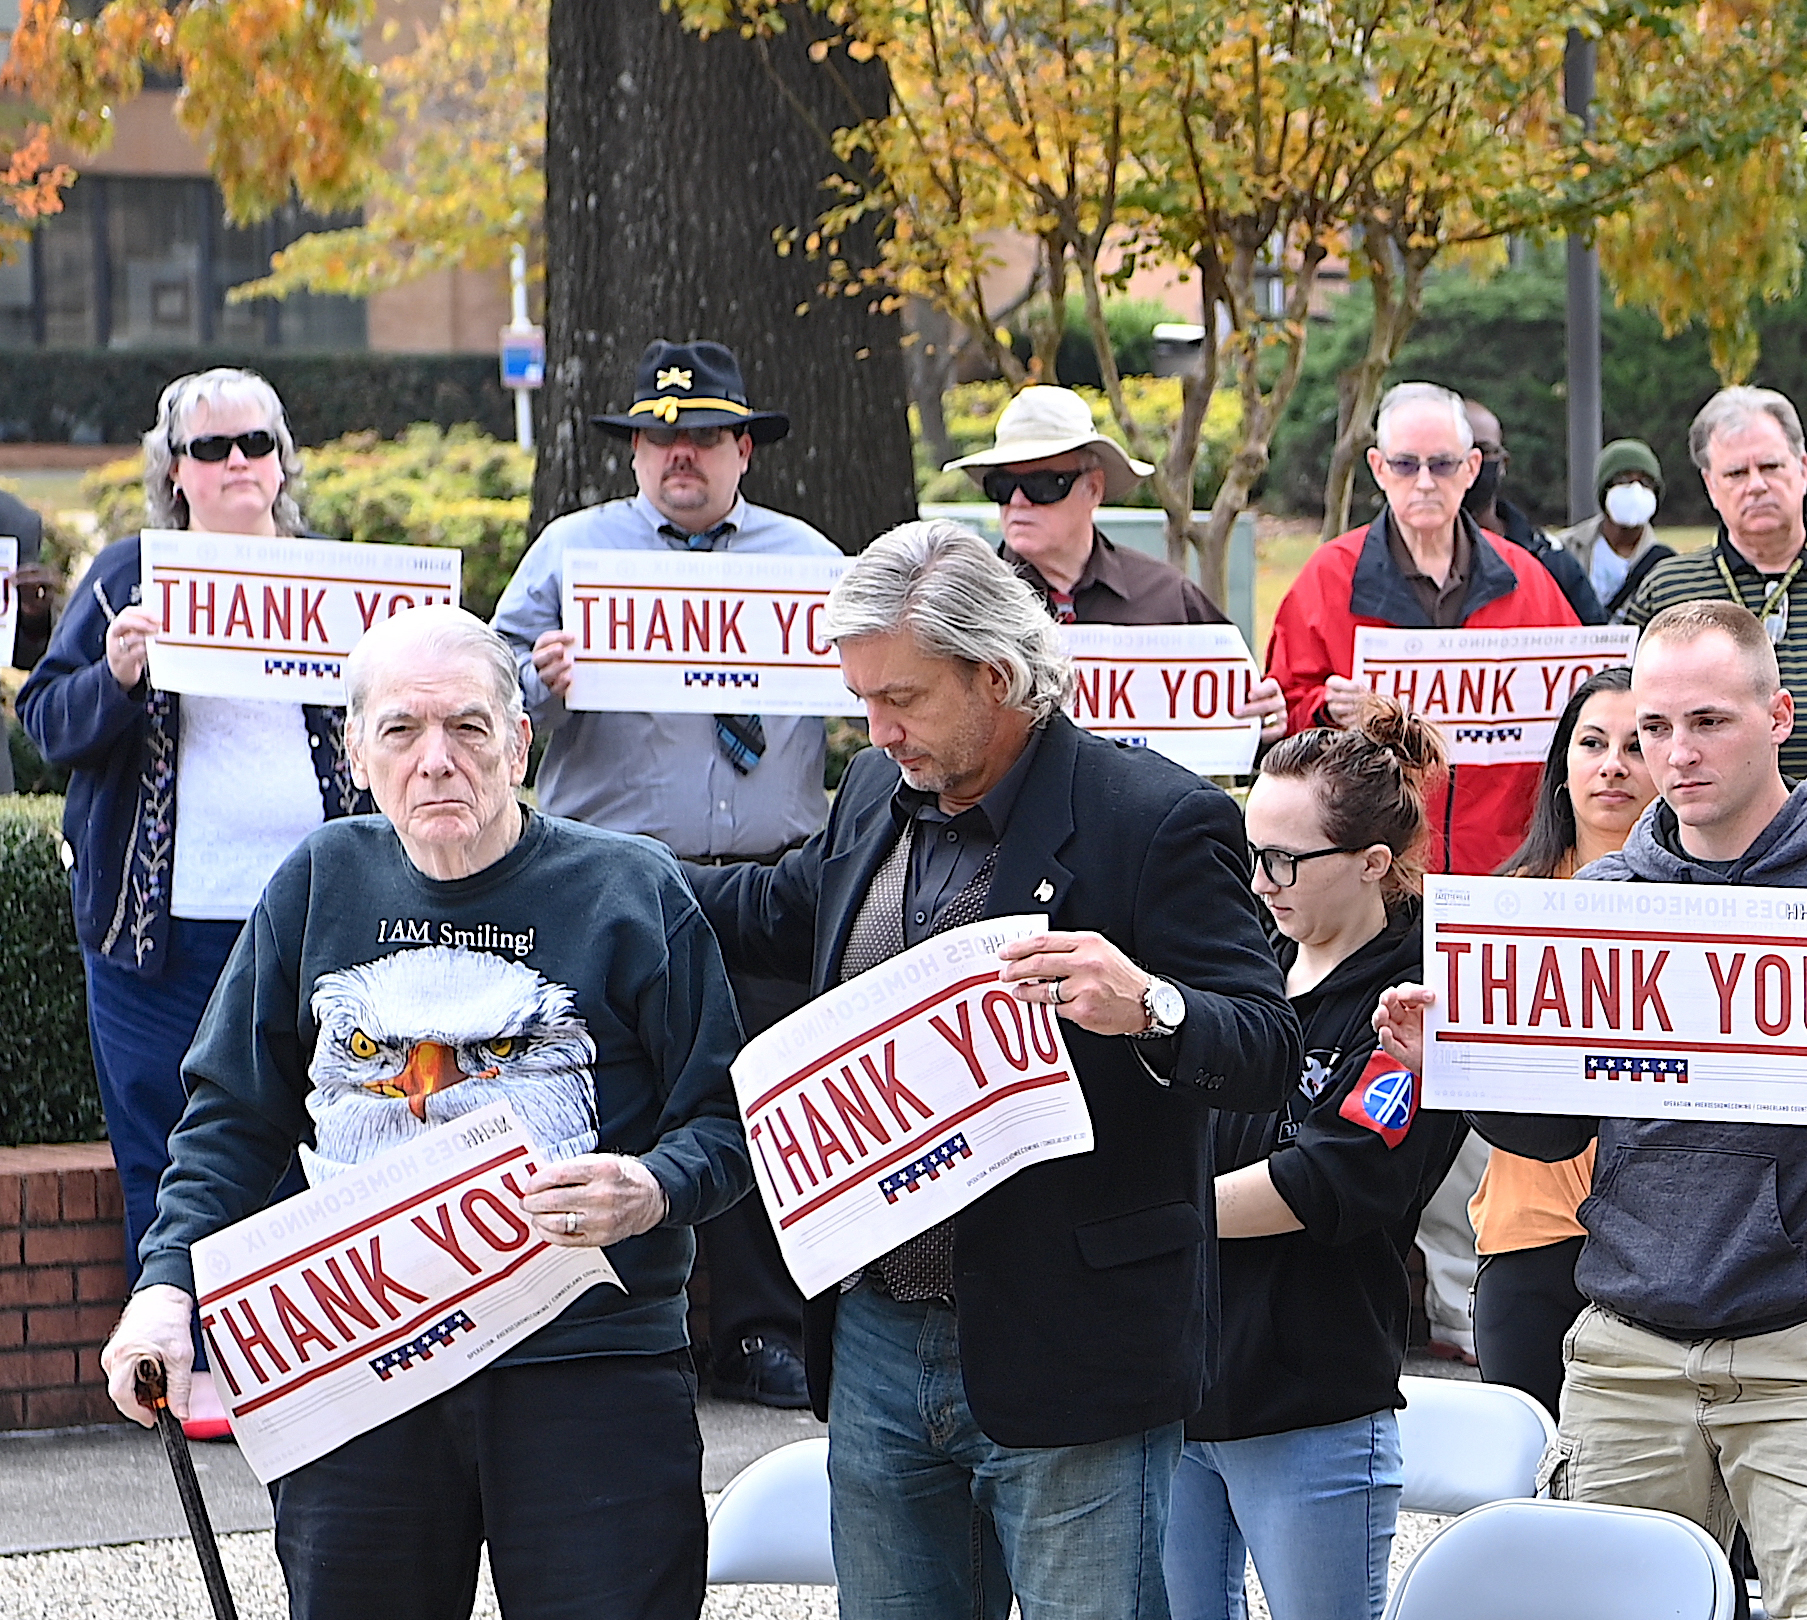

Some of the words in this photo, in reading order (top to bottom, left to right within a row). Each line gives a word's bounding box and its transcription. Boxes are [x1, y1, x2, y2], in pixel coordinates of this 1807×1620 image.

[153, 579, 328, 643] THANK
[574, 597, 747, 654] THANK
[773, 602, 832, 654] YO
[1161, 669, 1252, 719] YOU
[1364, 667, 1517, 714] THANK
[378, 920, 387, 942] I
[388, 919, 433, 943] AM
[439, 923, 534, 956] Smiling!
[1436, 943, 1673, 1032] THANK
[750, 1039, 934, 1207] THANK
[929, 990, 1059, 1089] YOU
[202, 1235, 429, 1396] THANK
